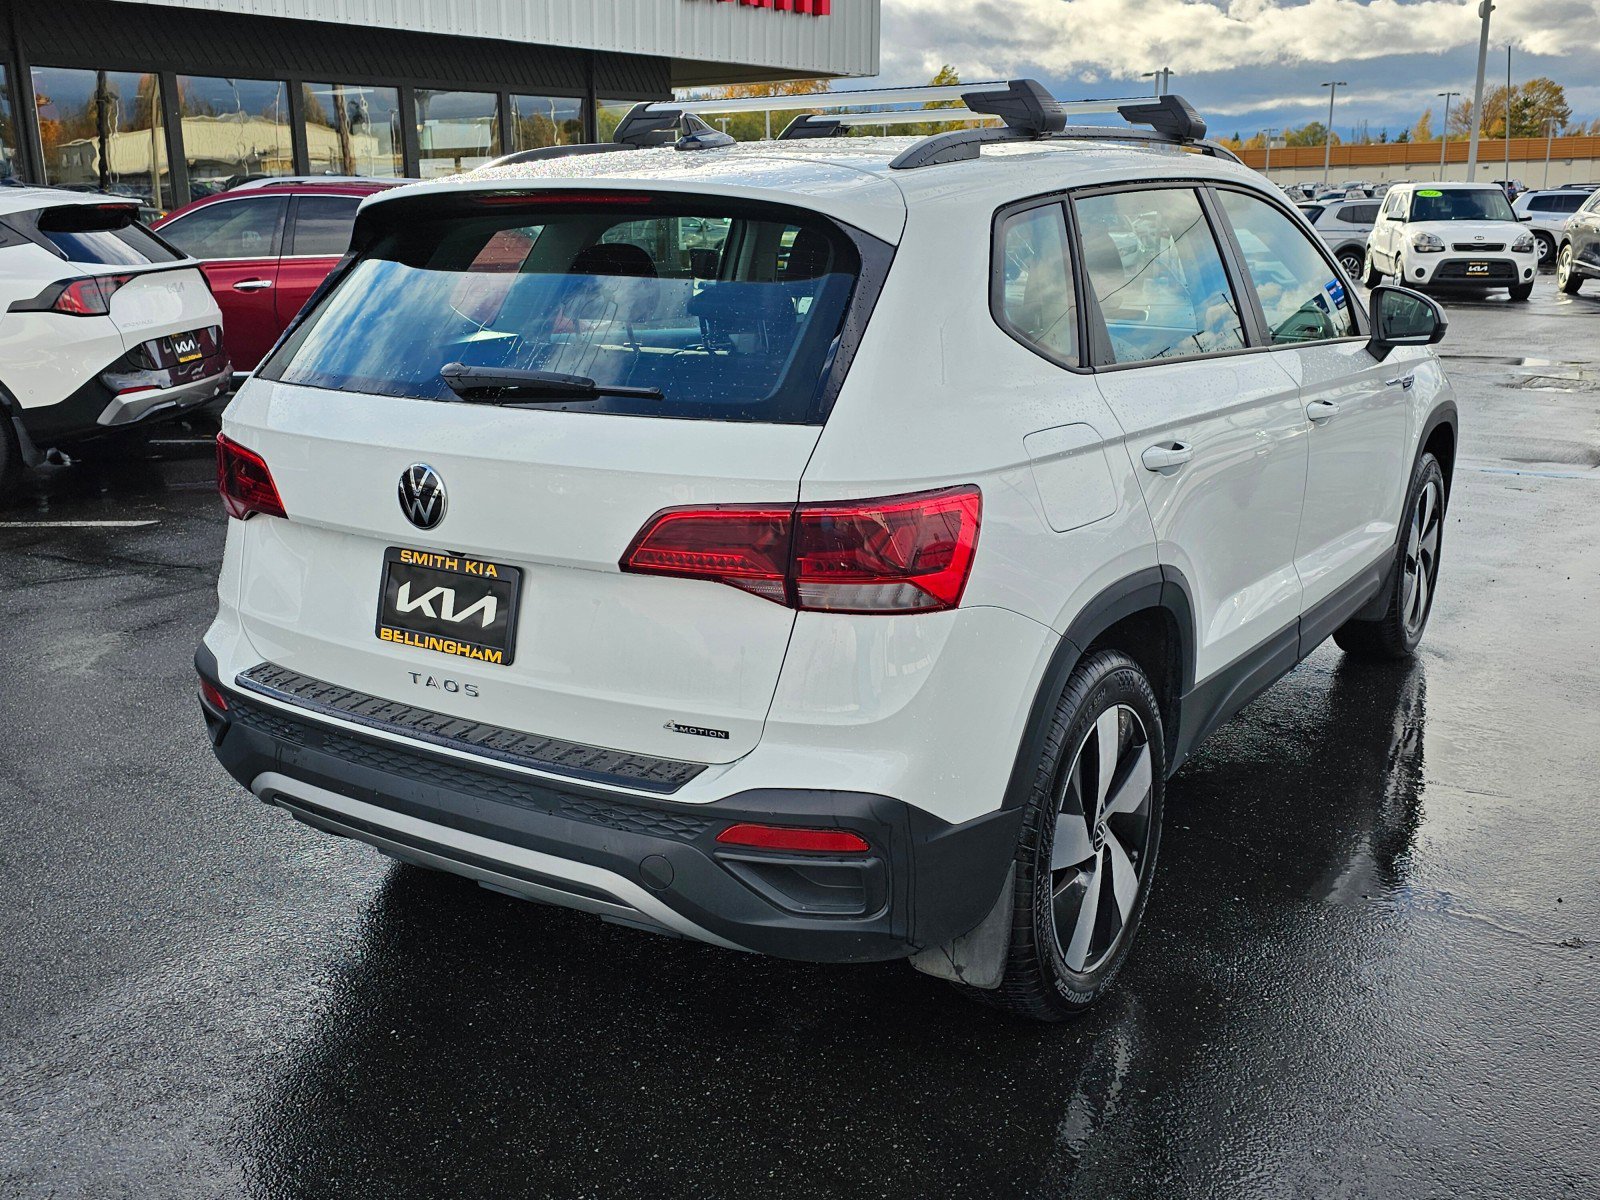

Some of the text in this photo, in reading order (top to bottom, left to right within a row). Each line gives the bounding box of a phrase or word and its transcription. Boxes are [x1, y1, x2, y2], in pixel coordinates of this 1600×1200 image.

[175, 339, 195, 354] KIA
[398, 462, 447, 529] VW
[400, 550, 498, 578] SMITH KIA
[396, 581, 498, 628] KIA
[380, 627, 503, 665] BELLINGHAM
[408, 671, 480, 698] TAOS
[663, 719, 726, 739] 4MOTION
